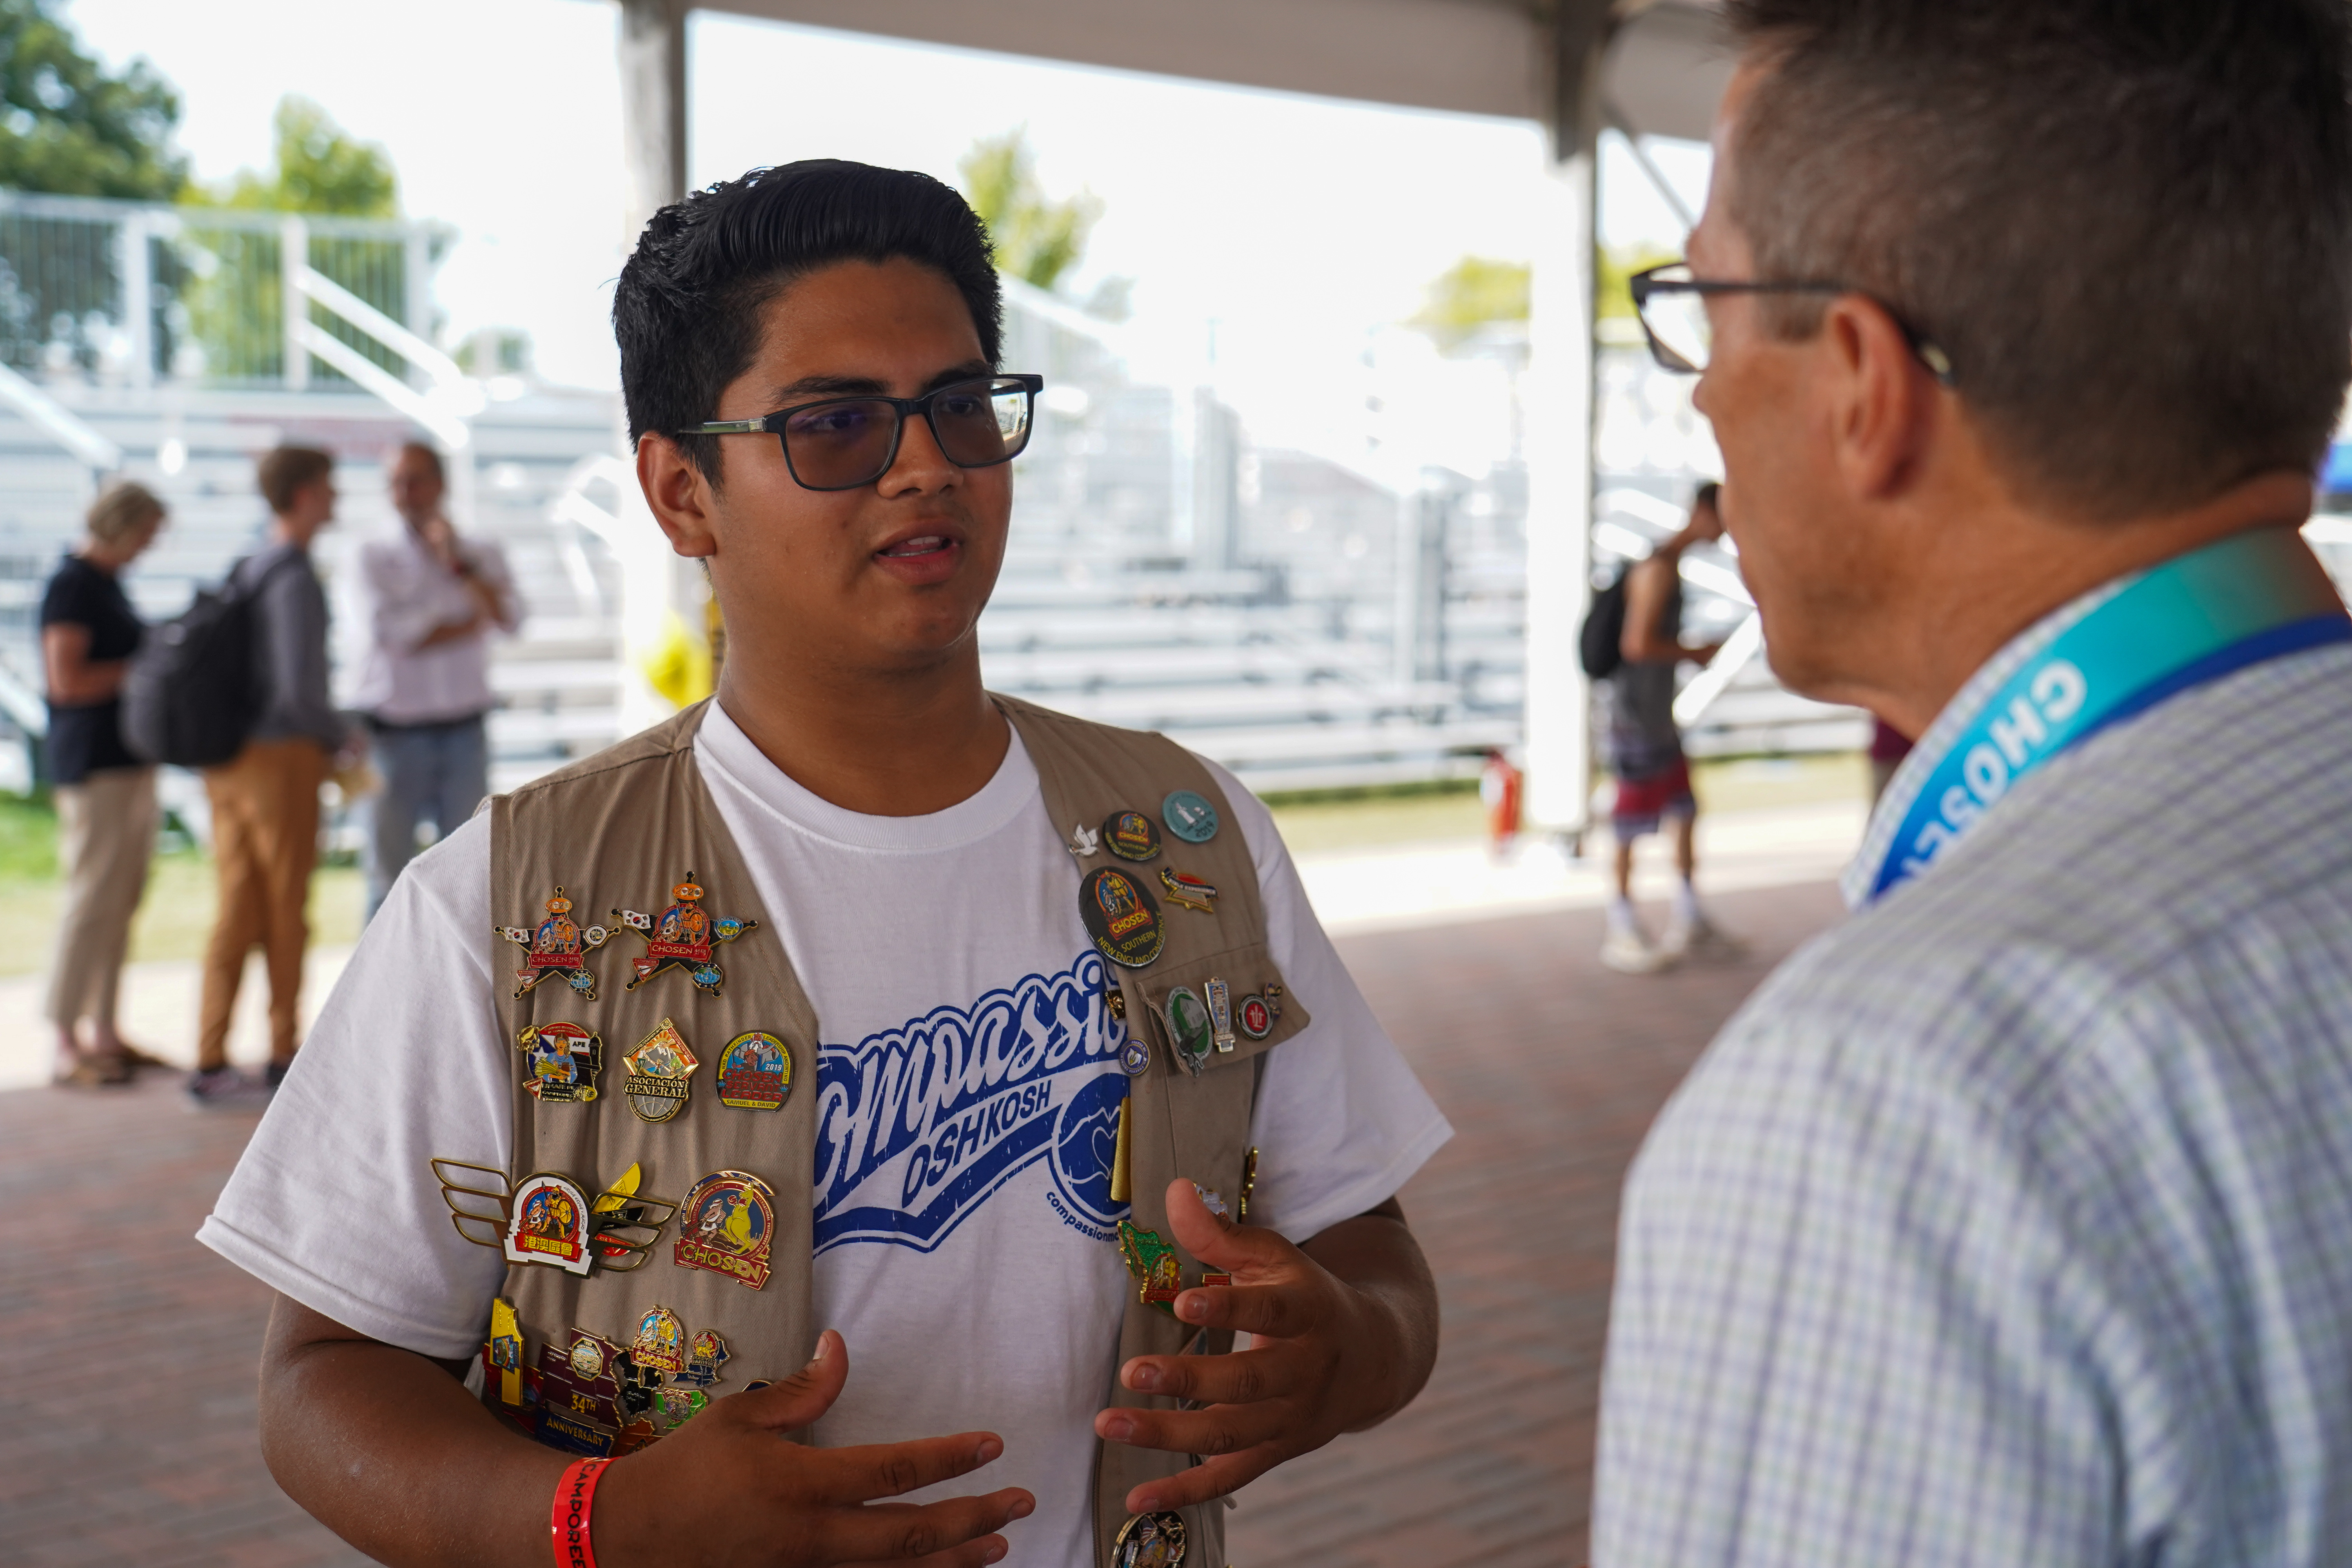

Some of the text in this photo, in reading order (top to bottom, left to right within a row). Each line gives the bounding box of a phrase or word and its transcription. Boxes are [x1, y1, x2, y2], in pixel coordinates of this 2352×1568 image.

[1119, 832, 1148, 842] CHOSEN
[1112, 909, 1148, 933] CHOSEN
[652, 945, 693, 954] CHOSEN
[1098, 936, 1116, 955] NEW
[1116, 951, 1149, 964] ENGLAND
[1122, 929, 1156, 952] SOUTHERN
[725, 1035, 751, 1057] PATHFINDER
[763, 1035, 786, 1055] LEADERSHIP
[627, 1077, 685, 1087] ASOCIACIÓN
[722, 1069, 782, 1083] CHOSEN
[726, 1080, 780, 1092] SERVANT
[625, 1084, 684, 1098] GENERAL
[722, 1089, 783, 1102] LEADER
[902, 1079, 1052, 1208] OSHKOSH
[563, 1186, 575, 1198] HONG
[574, 1197, 583, 1210] KONG
[682, 1196, 691, 1210] UNDER
[755, 1194, 770, 1221] INTERNATIONAL
[762, 1222, 771, 1245] PATHFINDER
[524, 1235, 573, 1256] 港澳區會
[682, 1244, 761, 1281] CHOSEN
[636, 1352, 676, 1370] CHOSEN
[571, 1394, 596, 1413] 34TH
[546, 1416, 604, 1446] ANNIVERSARY
[568, 1464, 596, 1568] CAMPOREE
